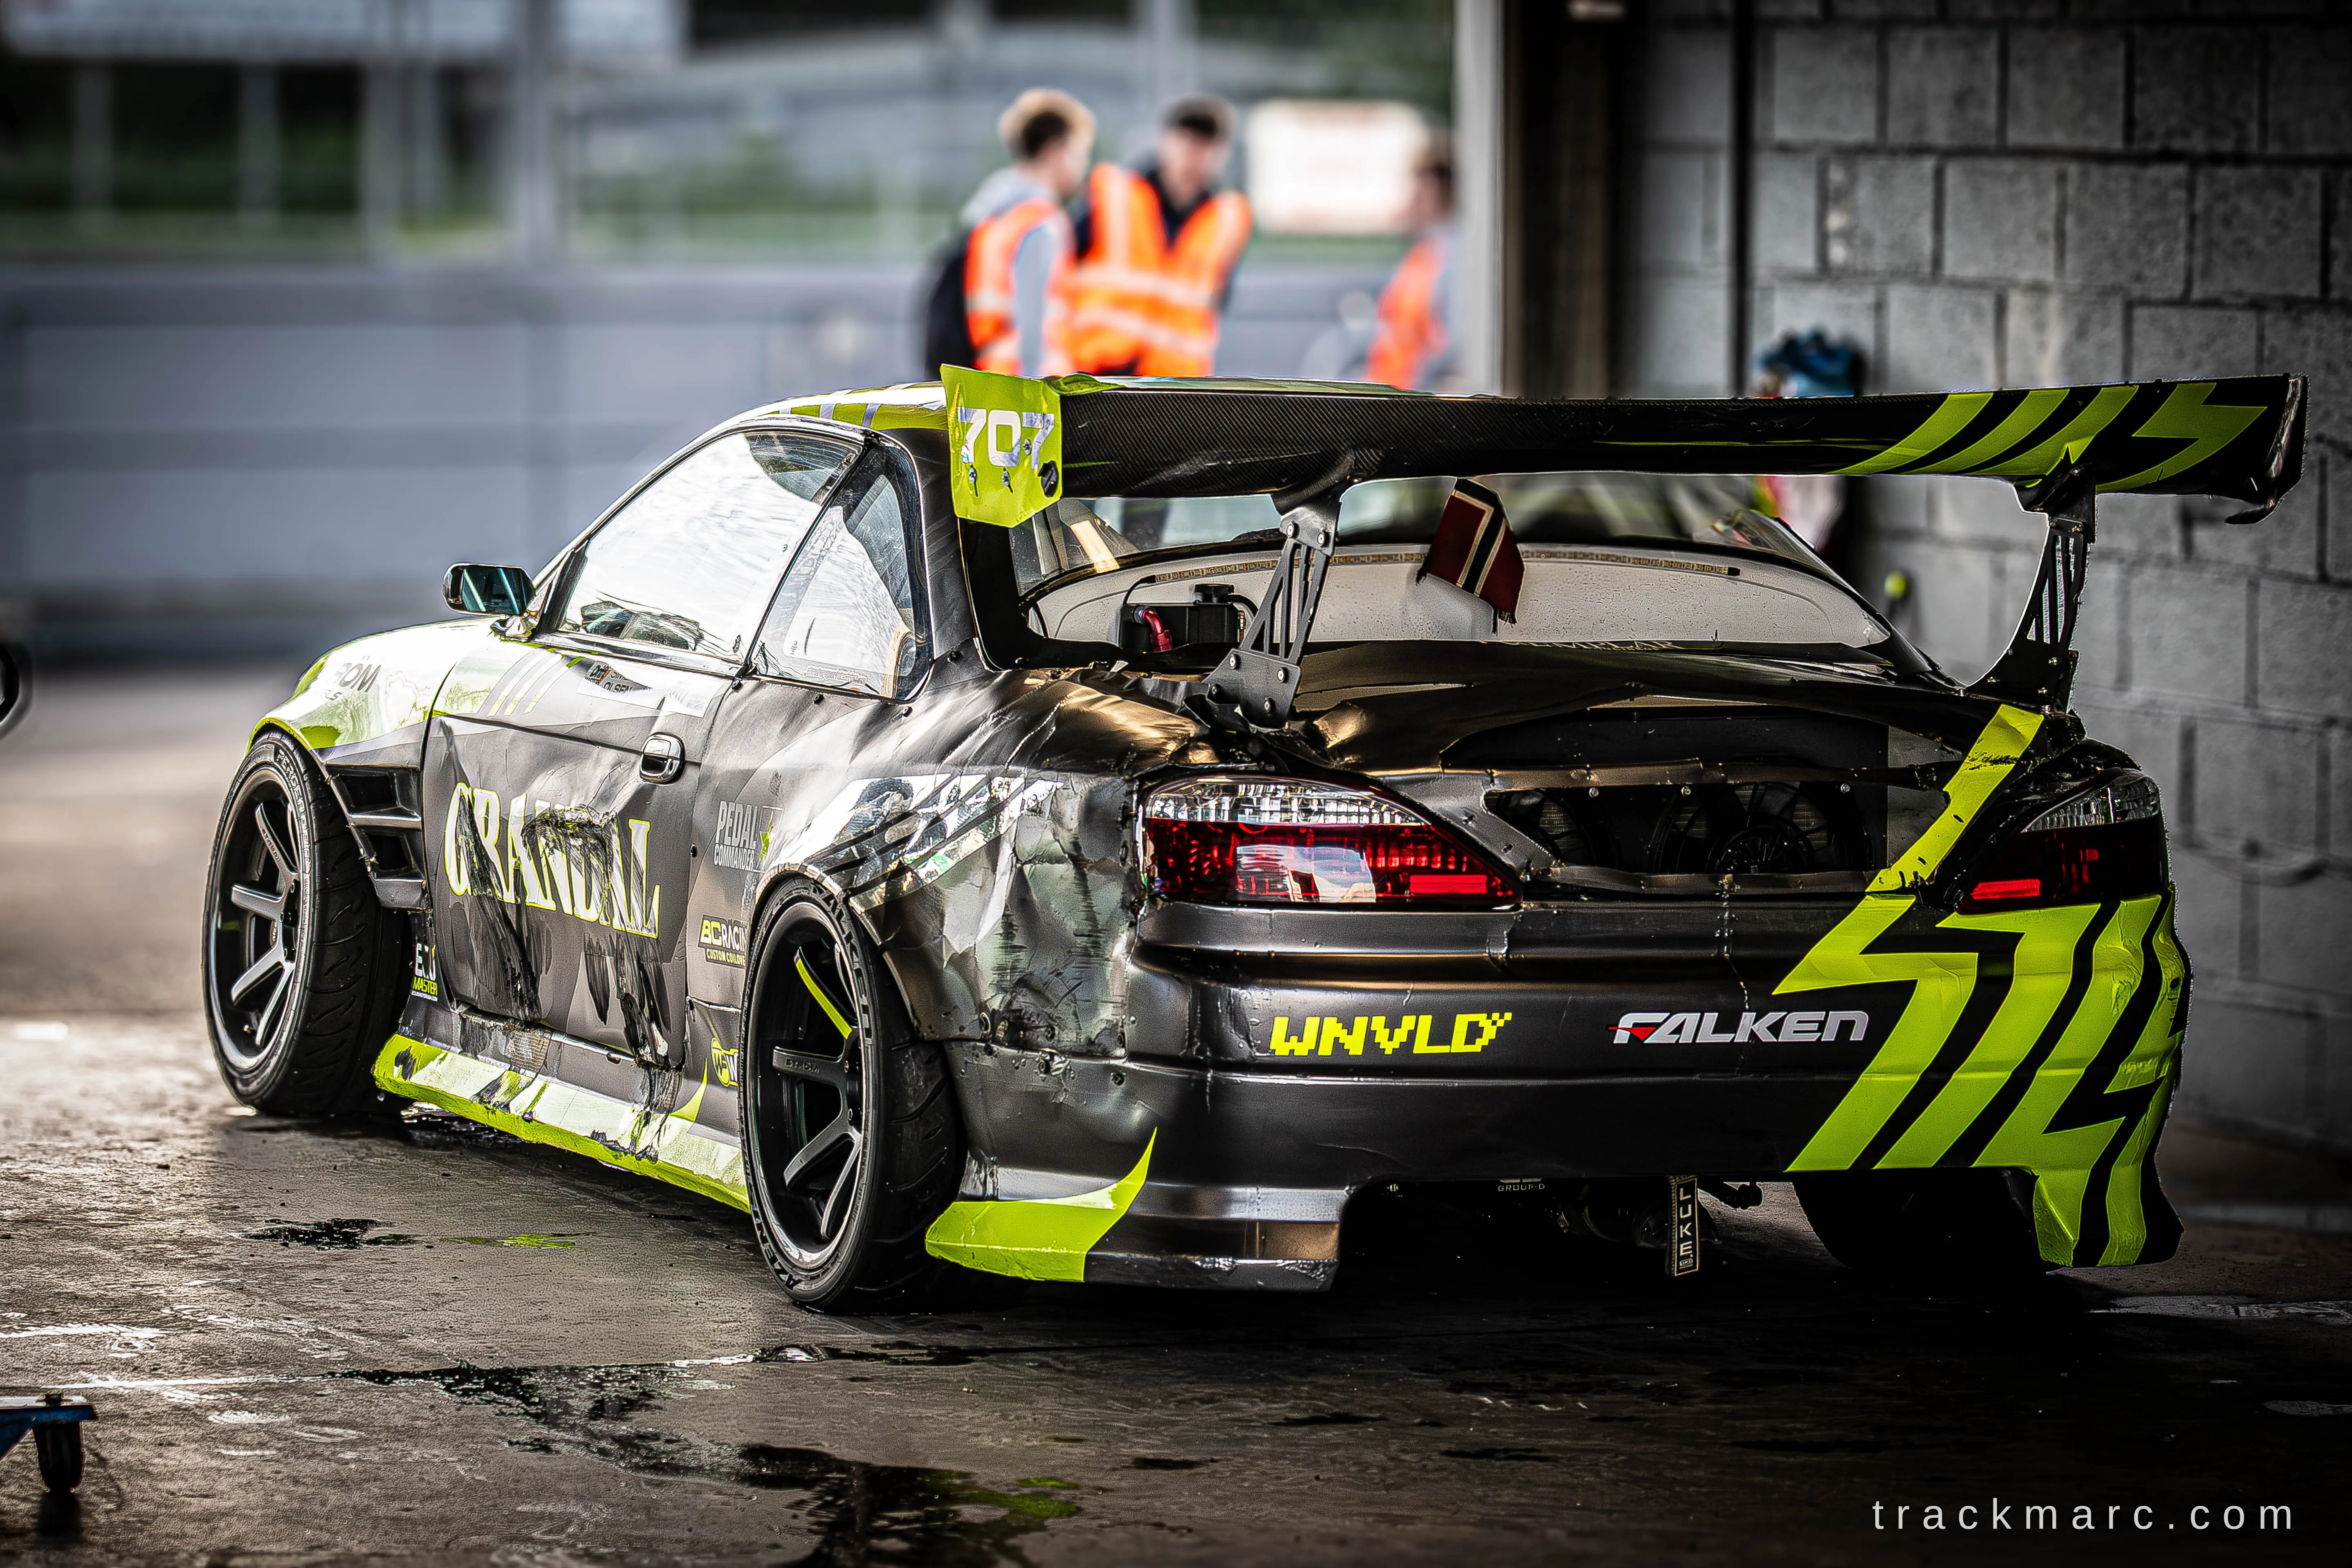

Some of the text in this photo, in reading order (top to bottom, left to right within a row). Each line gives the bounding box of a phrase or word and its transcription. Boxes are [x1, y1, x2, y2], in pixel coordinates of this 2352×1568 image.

[957, 407, 1054, 469] 707
[604, 682, 633, 694] OLSEN
[716, 801, 758, 849] PEDAL
[714, 844, 755, 871] COMMANDER
[706, 948, 726, 962] CUSTOM
[413, 976, 437, 996] MASTER
[1270, 1012, 1512, 1055] WNVLD
[1609, 1011, 1868, 1043] FALKEN
